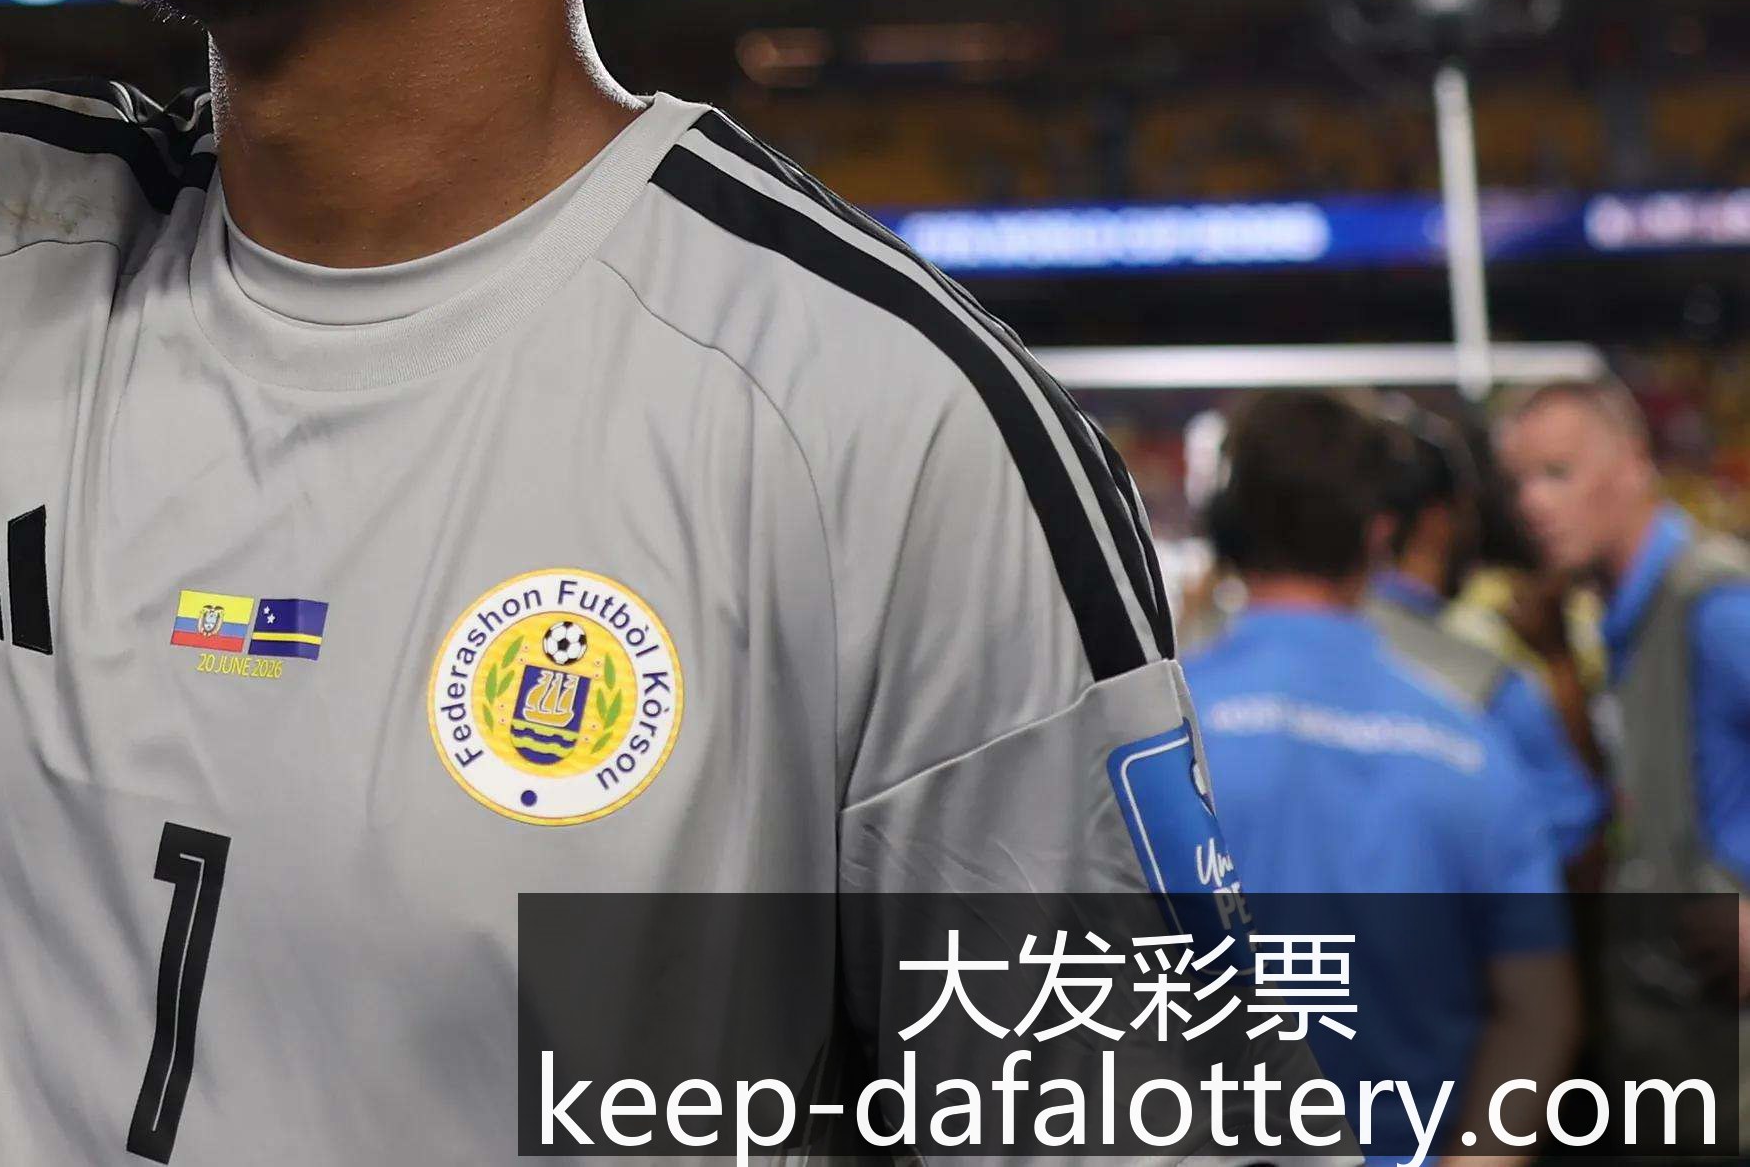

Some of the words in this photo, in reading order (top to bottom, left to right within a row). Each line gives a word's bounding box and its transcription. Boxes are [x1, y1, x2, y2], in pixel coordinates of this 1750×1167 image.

[196, 652, 215, 672] 20
[215, 654, 250, 676] JUNE
[251, 659, 283, 679] 2026
[441, 589, 542, 767] Federashon
[557, 580, 659, 657] Futbòl
[126, 821, 232, 1165] 1
